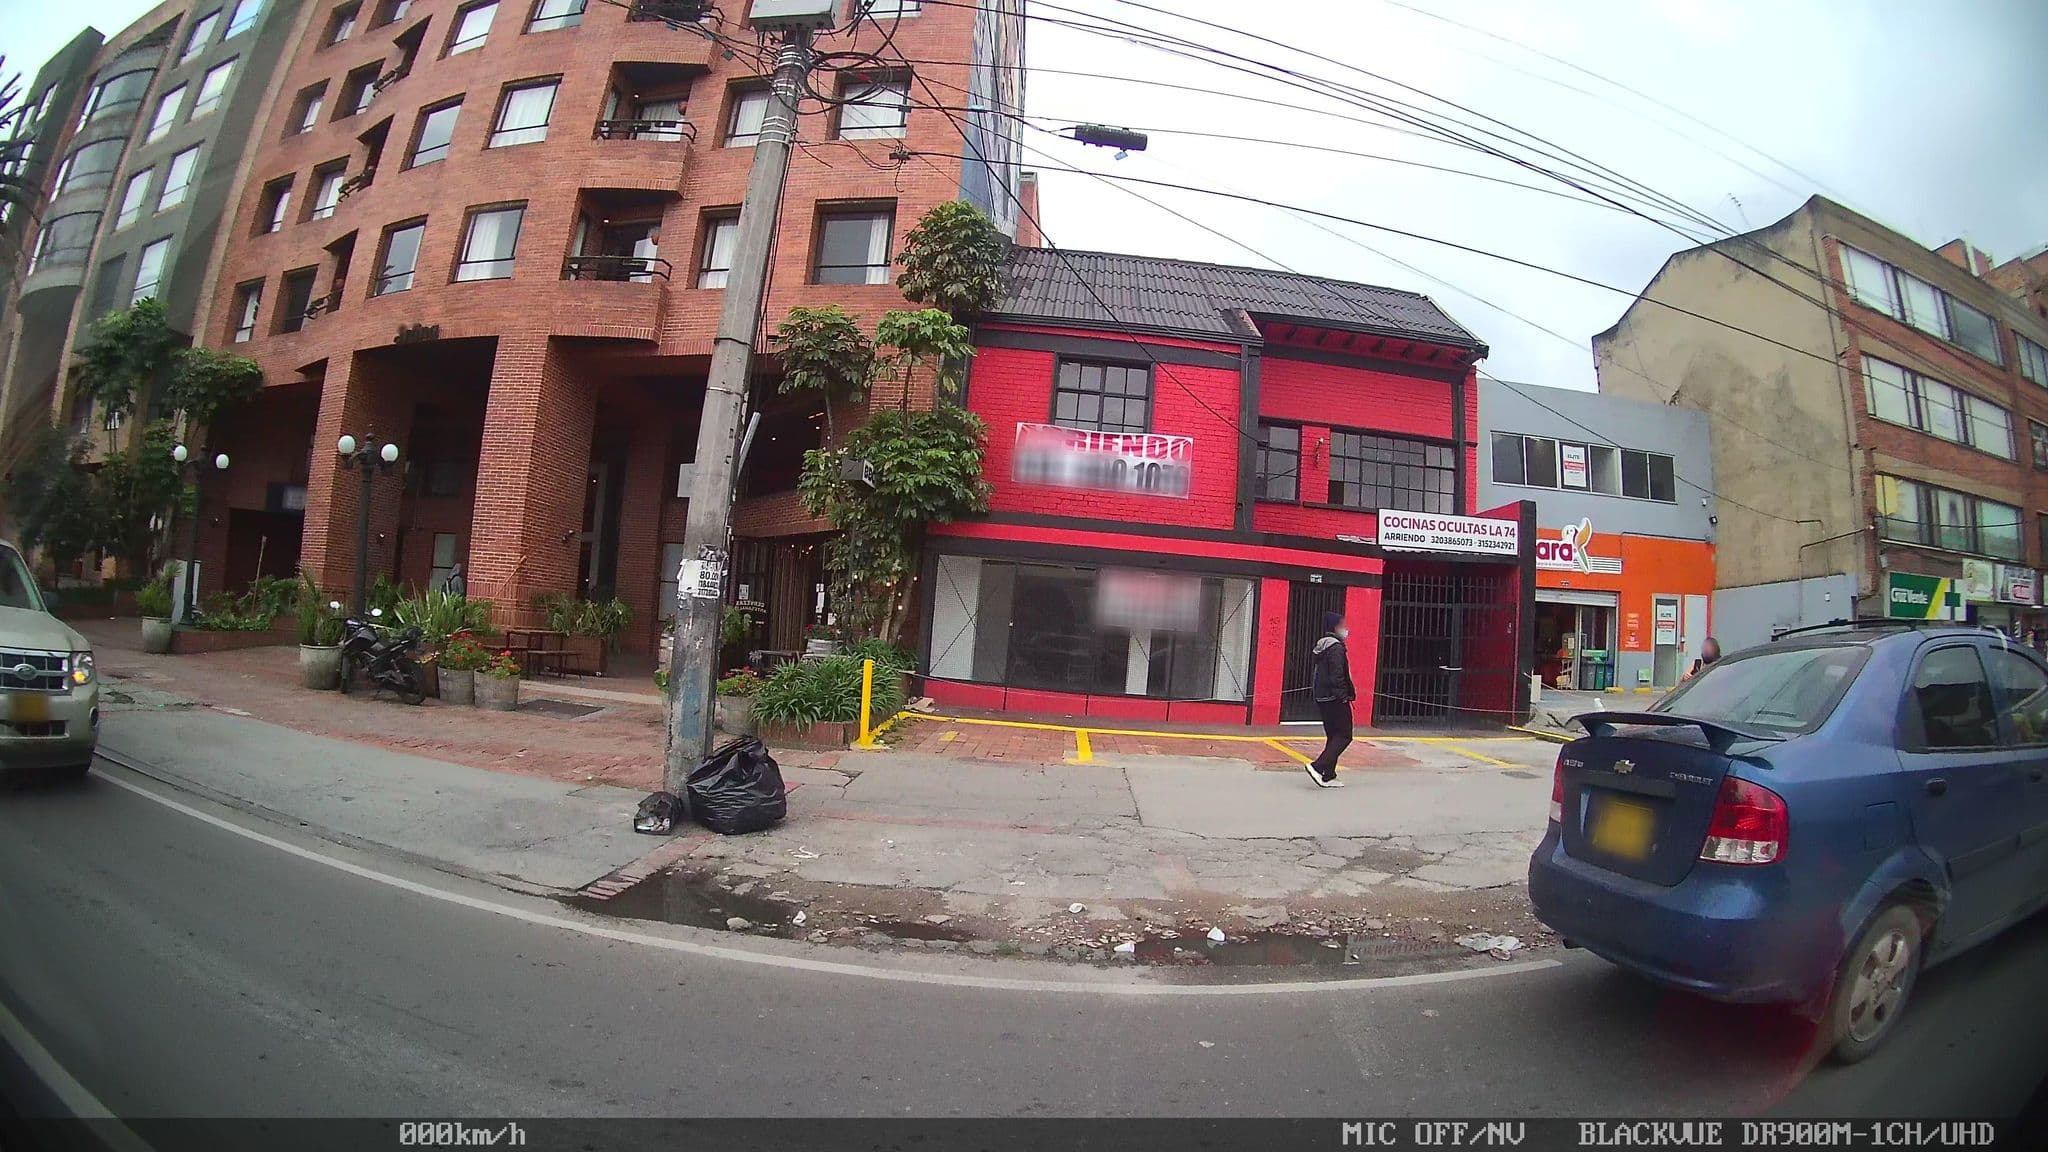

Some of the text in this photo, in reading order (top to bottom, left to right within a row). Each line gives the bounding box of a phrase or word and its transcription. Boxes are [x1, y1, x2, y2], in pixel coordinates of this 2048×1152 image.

[1383, 516, 1516, 538] COCINAS OCULTAS LA 74
[1384, 532, 1426, 543] ARRIENDO
[1536, 541, 1573, 561] ara
